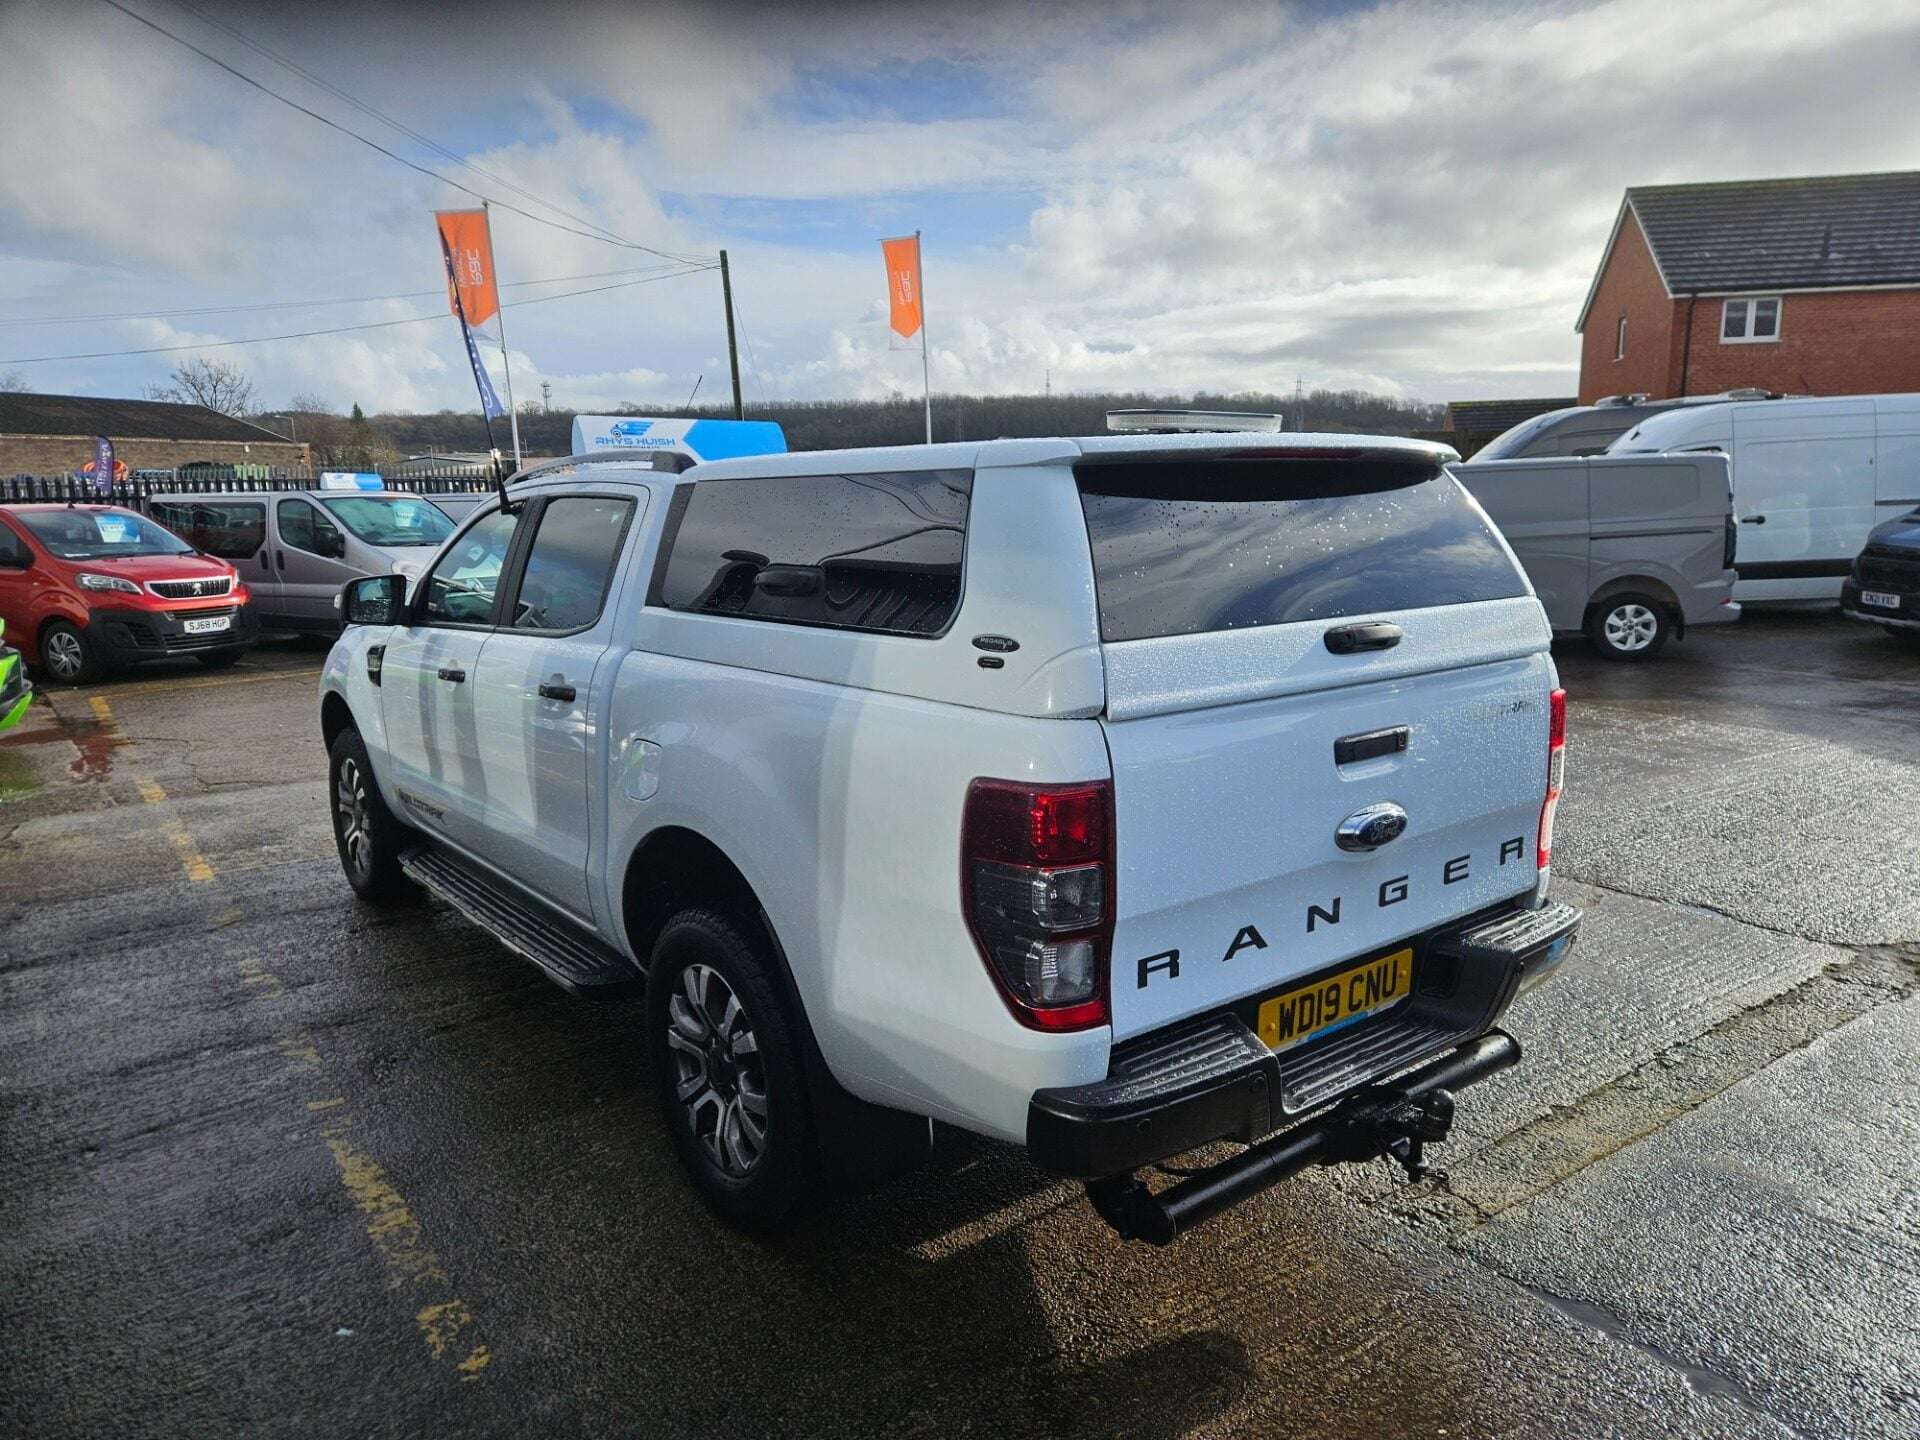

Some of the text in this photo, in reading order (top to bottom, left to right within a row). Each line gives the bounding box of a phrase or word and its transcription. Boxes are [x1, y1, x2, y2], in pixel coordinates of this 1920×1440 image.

[595, 436, 633, 446] RHYS
[1137, 836, 1524, 989] RANGER
[1278, 959, 1399, 1042] WD19 CNU
